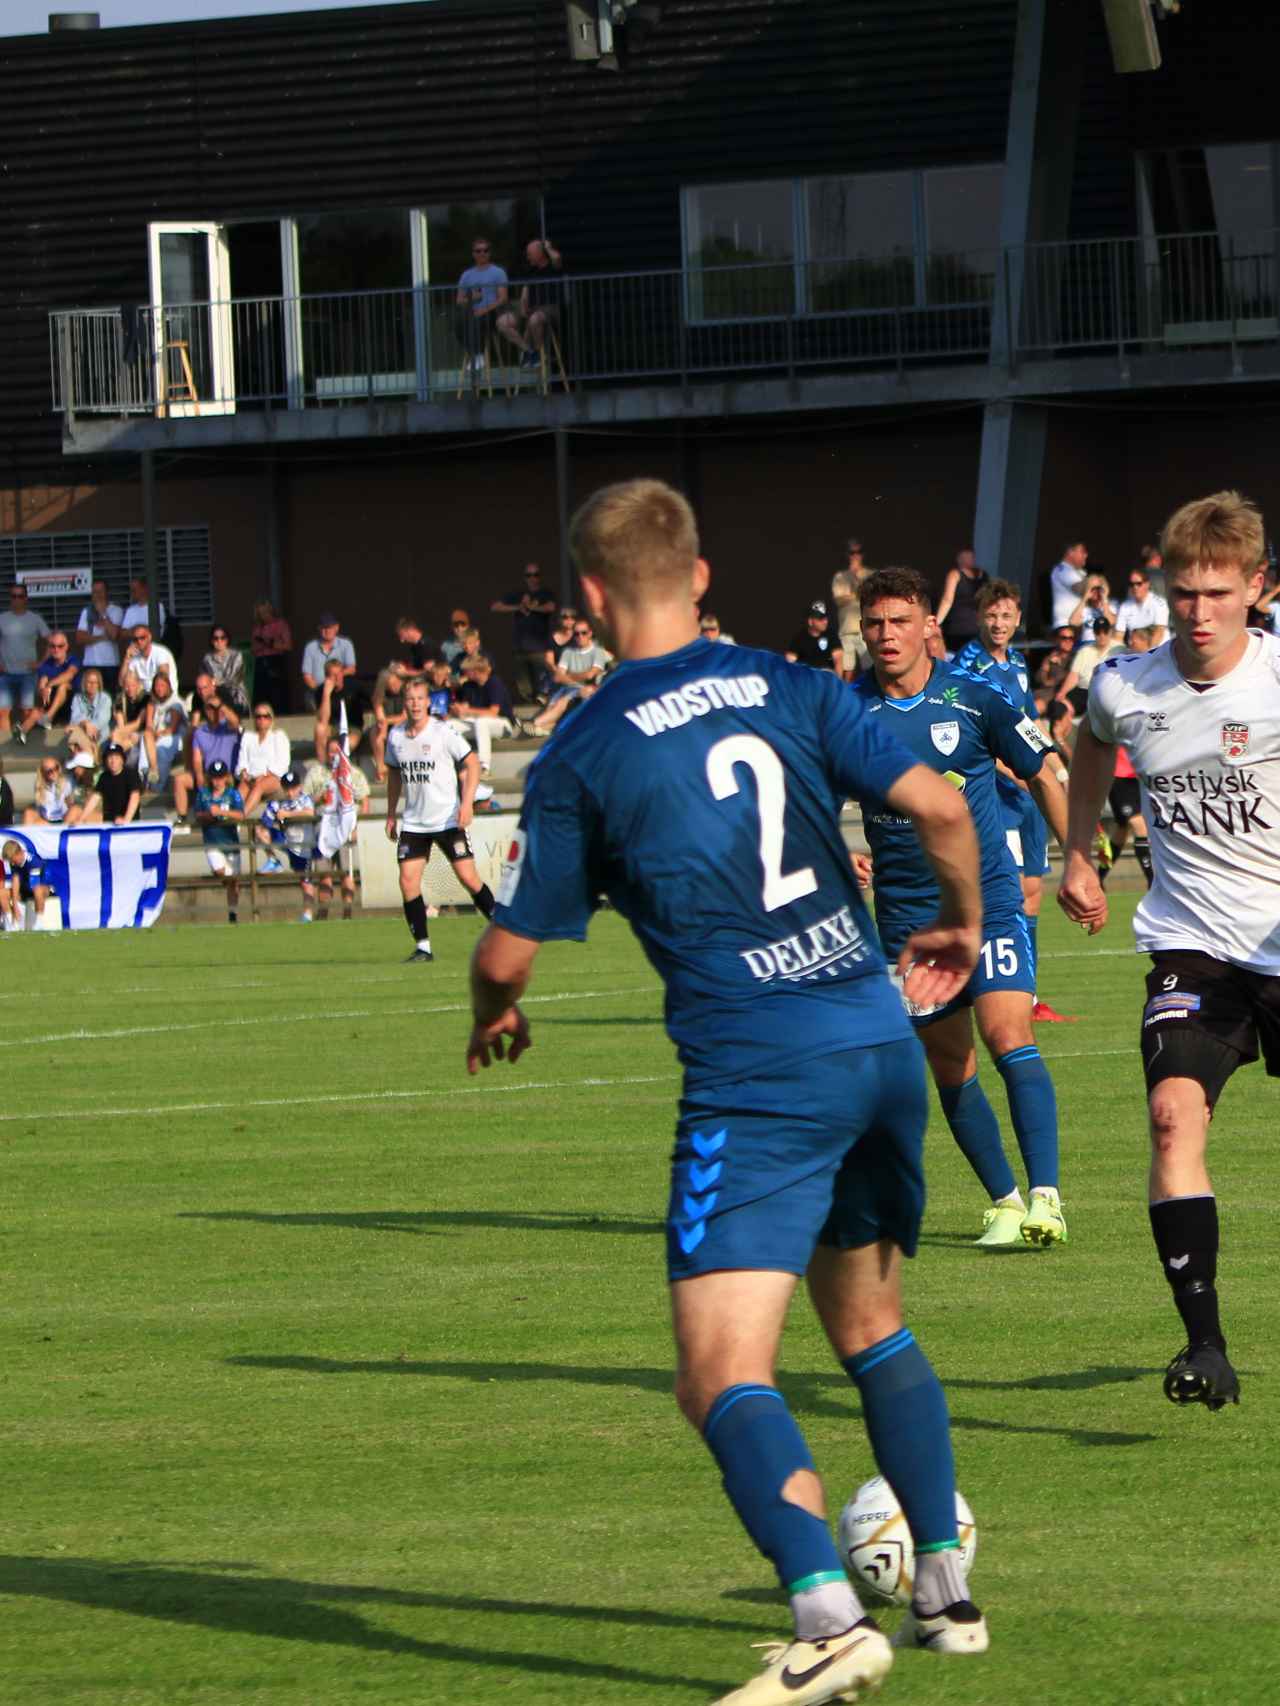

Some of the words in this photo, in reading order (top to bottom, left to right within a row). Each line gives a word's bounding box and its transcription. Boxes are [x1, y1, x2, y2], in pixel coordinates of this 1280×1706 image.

[624, 674, 769, 736] VADSTRUP
[400, 760, 436, 775] KJERN
[706, 734, 818, 912] 2
[980, 937, 1019, 980] 15
[1162, 973, 1179, 991] 9
